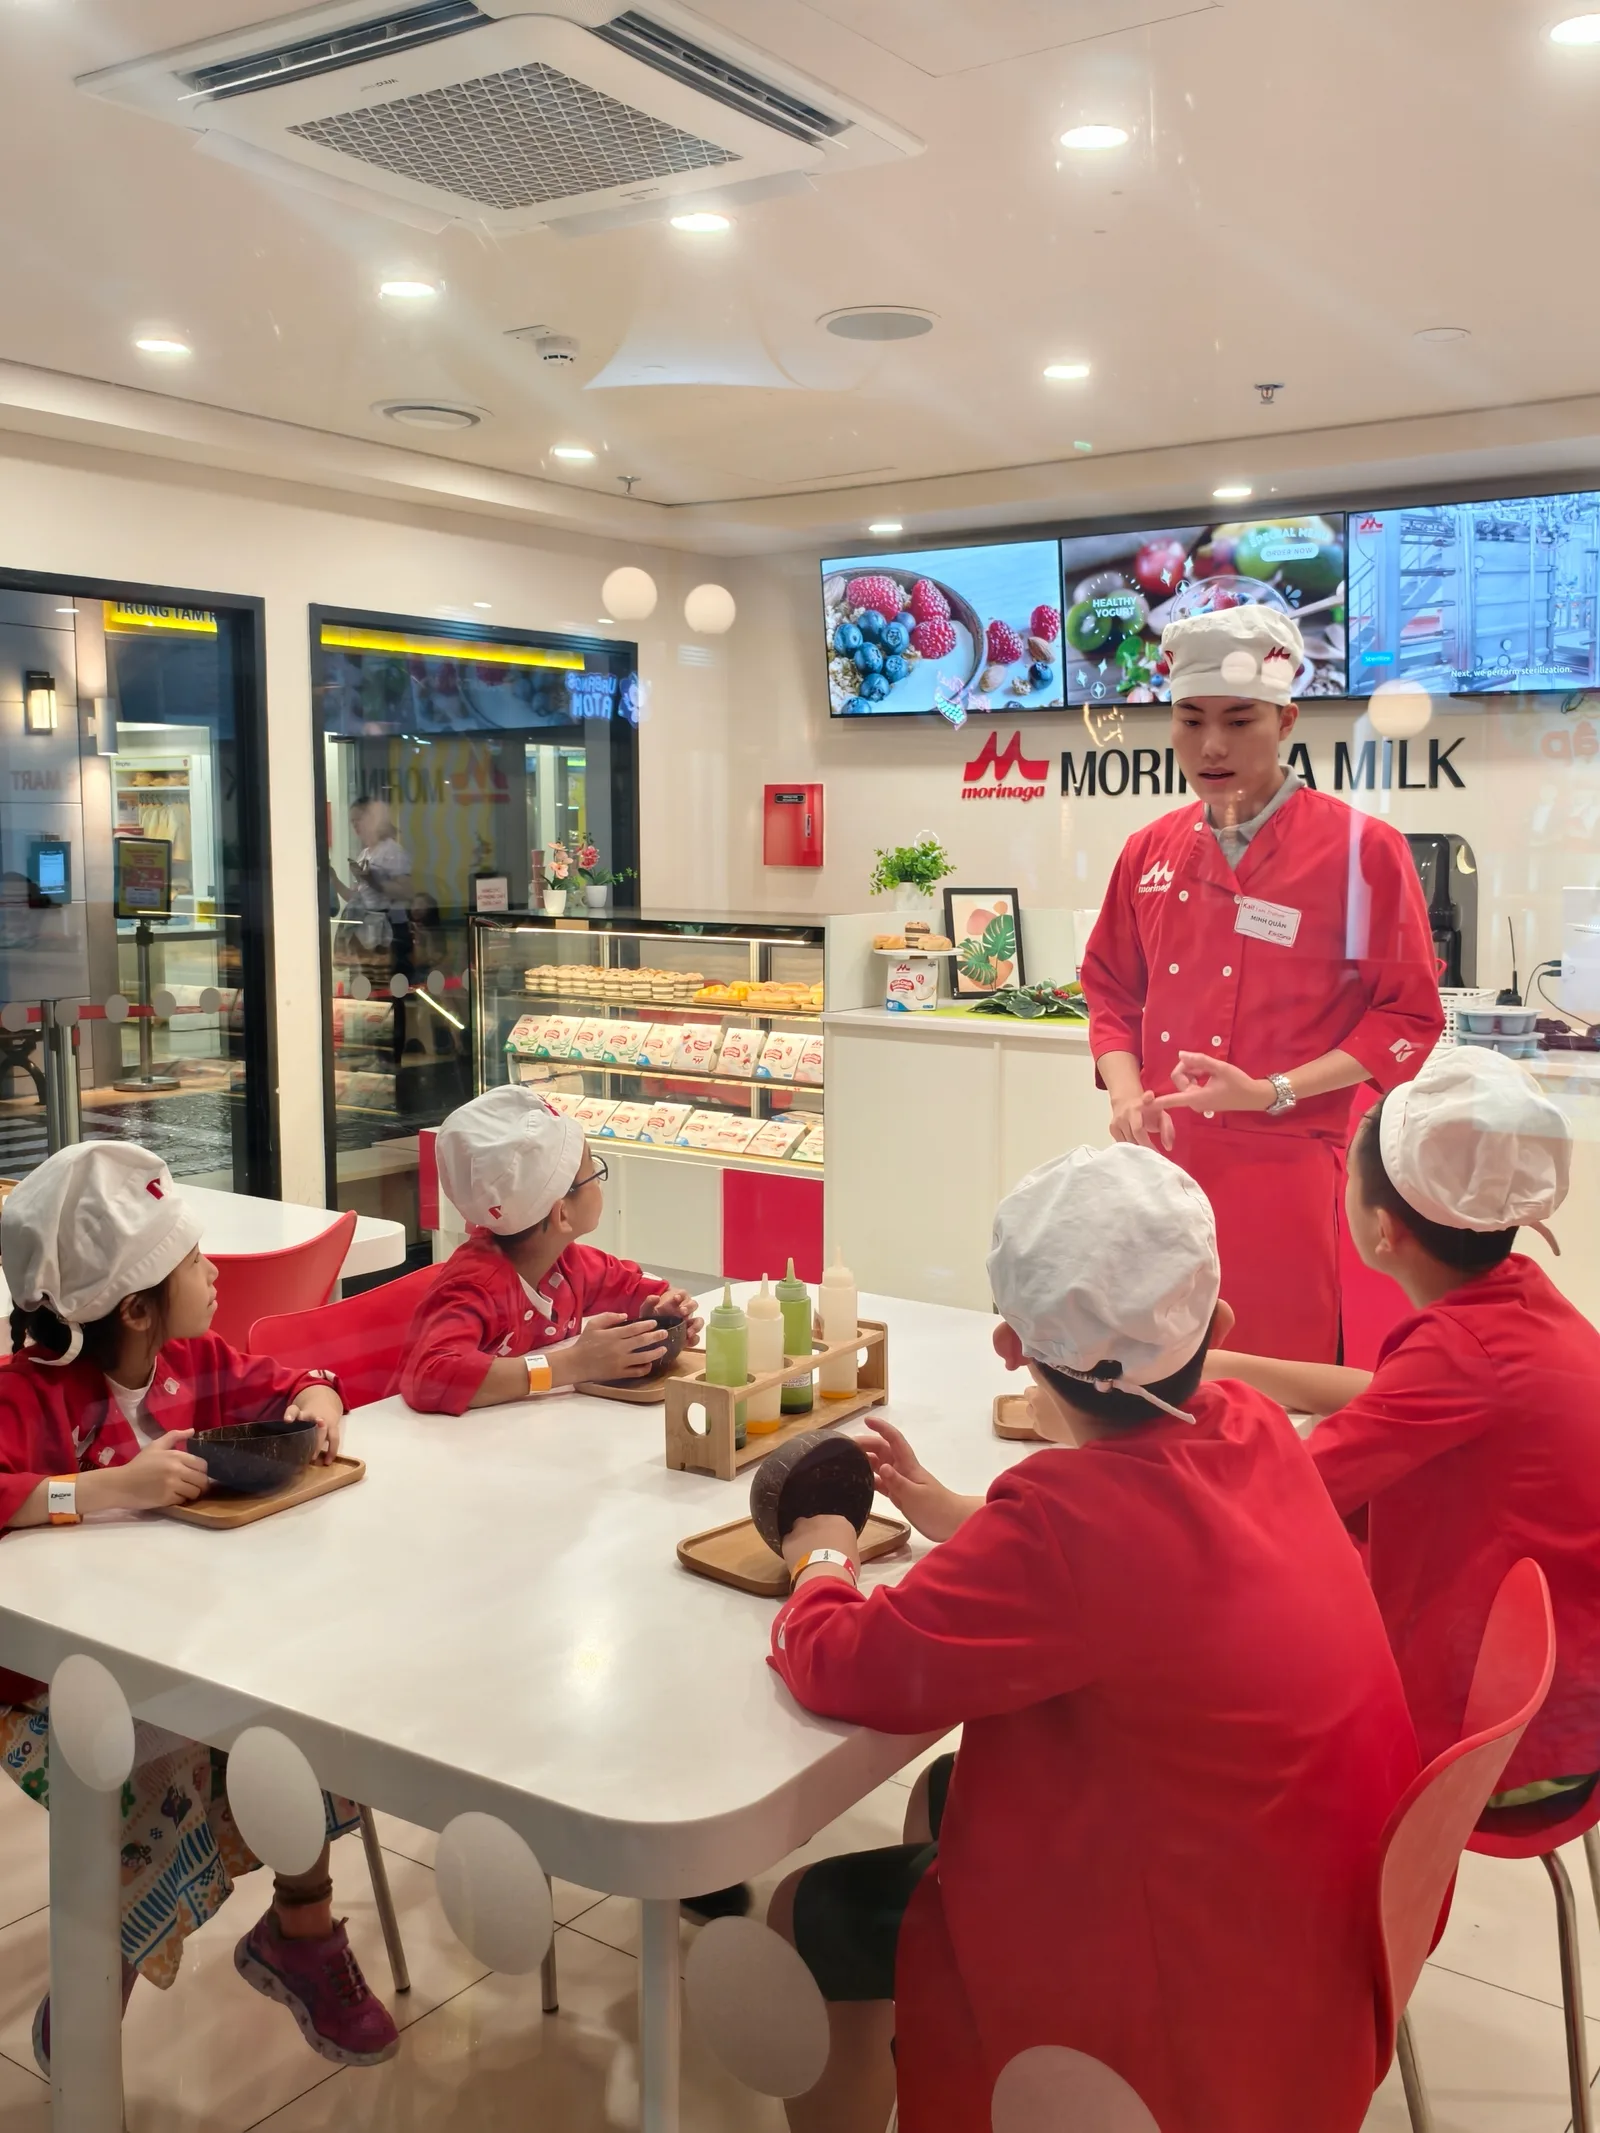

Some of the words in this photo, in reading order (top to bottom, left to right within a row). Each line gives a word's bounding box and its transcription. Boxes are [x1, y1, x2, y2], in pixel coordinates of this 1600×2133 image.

[1266, 548, 1291, 557] ORDER
[1293, 547, 1313, 555] NOW
[1092, 596, 1137, 608] HEALTHY
[1095, 606, 1136, 618] YOGURT
[1451, 669, 1473, 678] Next,
[1486, 668, 1519, 679] perform
[1521, 665, 1573, 675] sterilization.
[1060, 742, 1317, 797] MORIA
[1333, 736, 1467, 791] MILK
[961, 783, 1045, 802] morinaga
[1250, 915, 1267, 924] MINH
[1268, 919, 1287, 929] QUÂN
